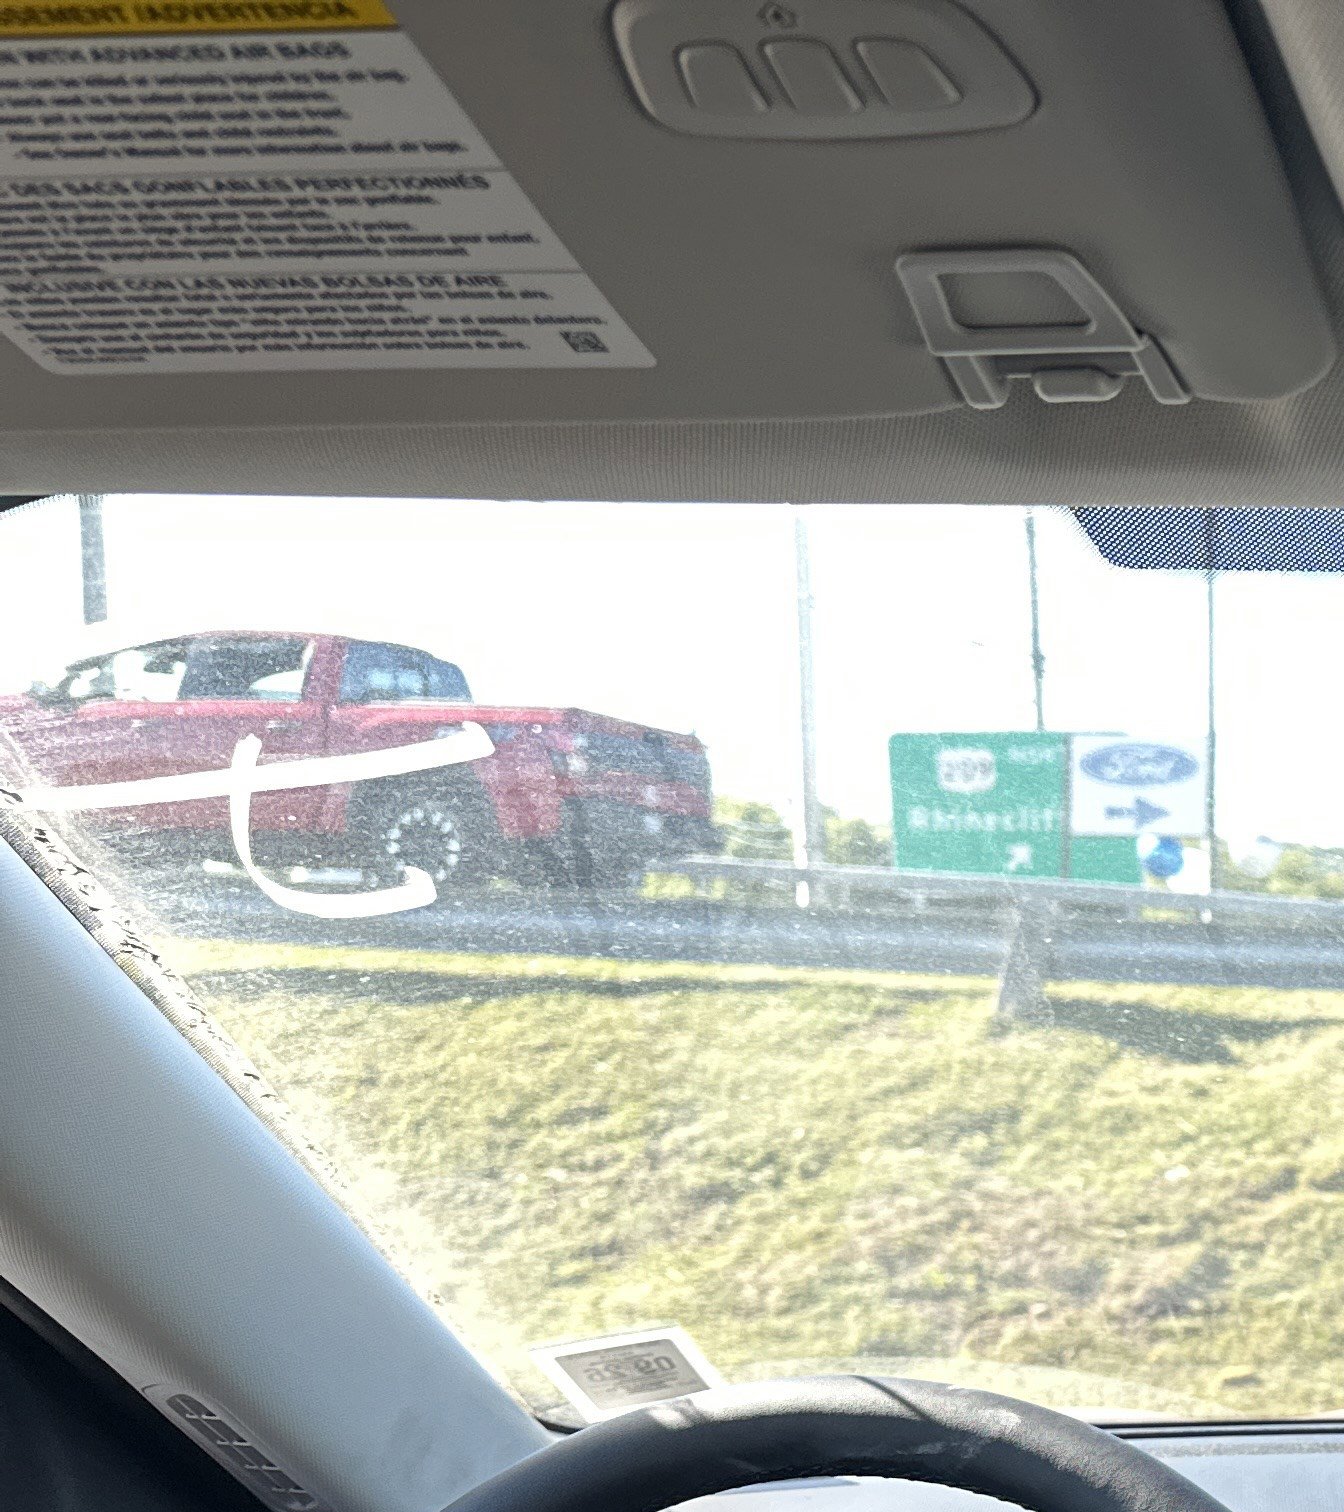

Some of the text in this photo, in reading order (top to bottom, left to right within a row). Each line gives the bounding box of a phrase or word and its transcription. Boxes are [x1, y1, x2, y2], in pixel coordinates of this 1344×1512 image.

[89, 44, 227, 64] ADVANCED
[229, 42, 271, 61] AIR
[273, 40, 351, 60] BAGS
